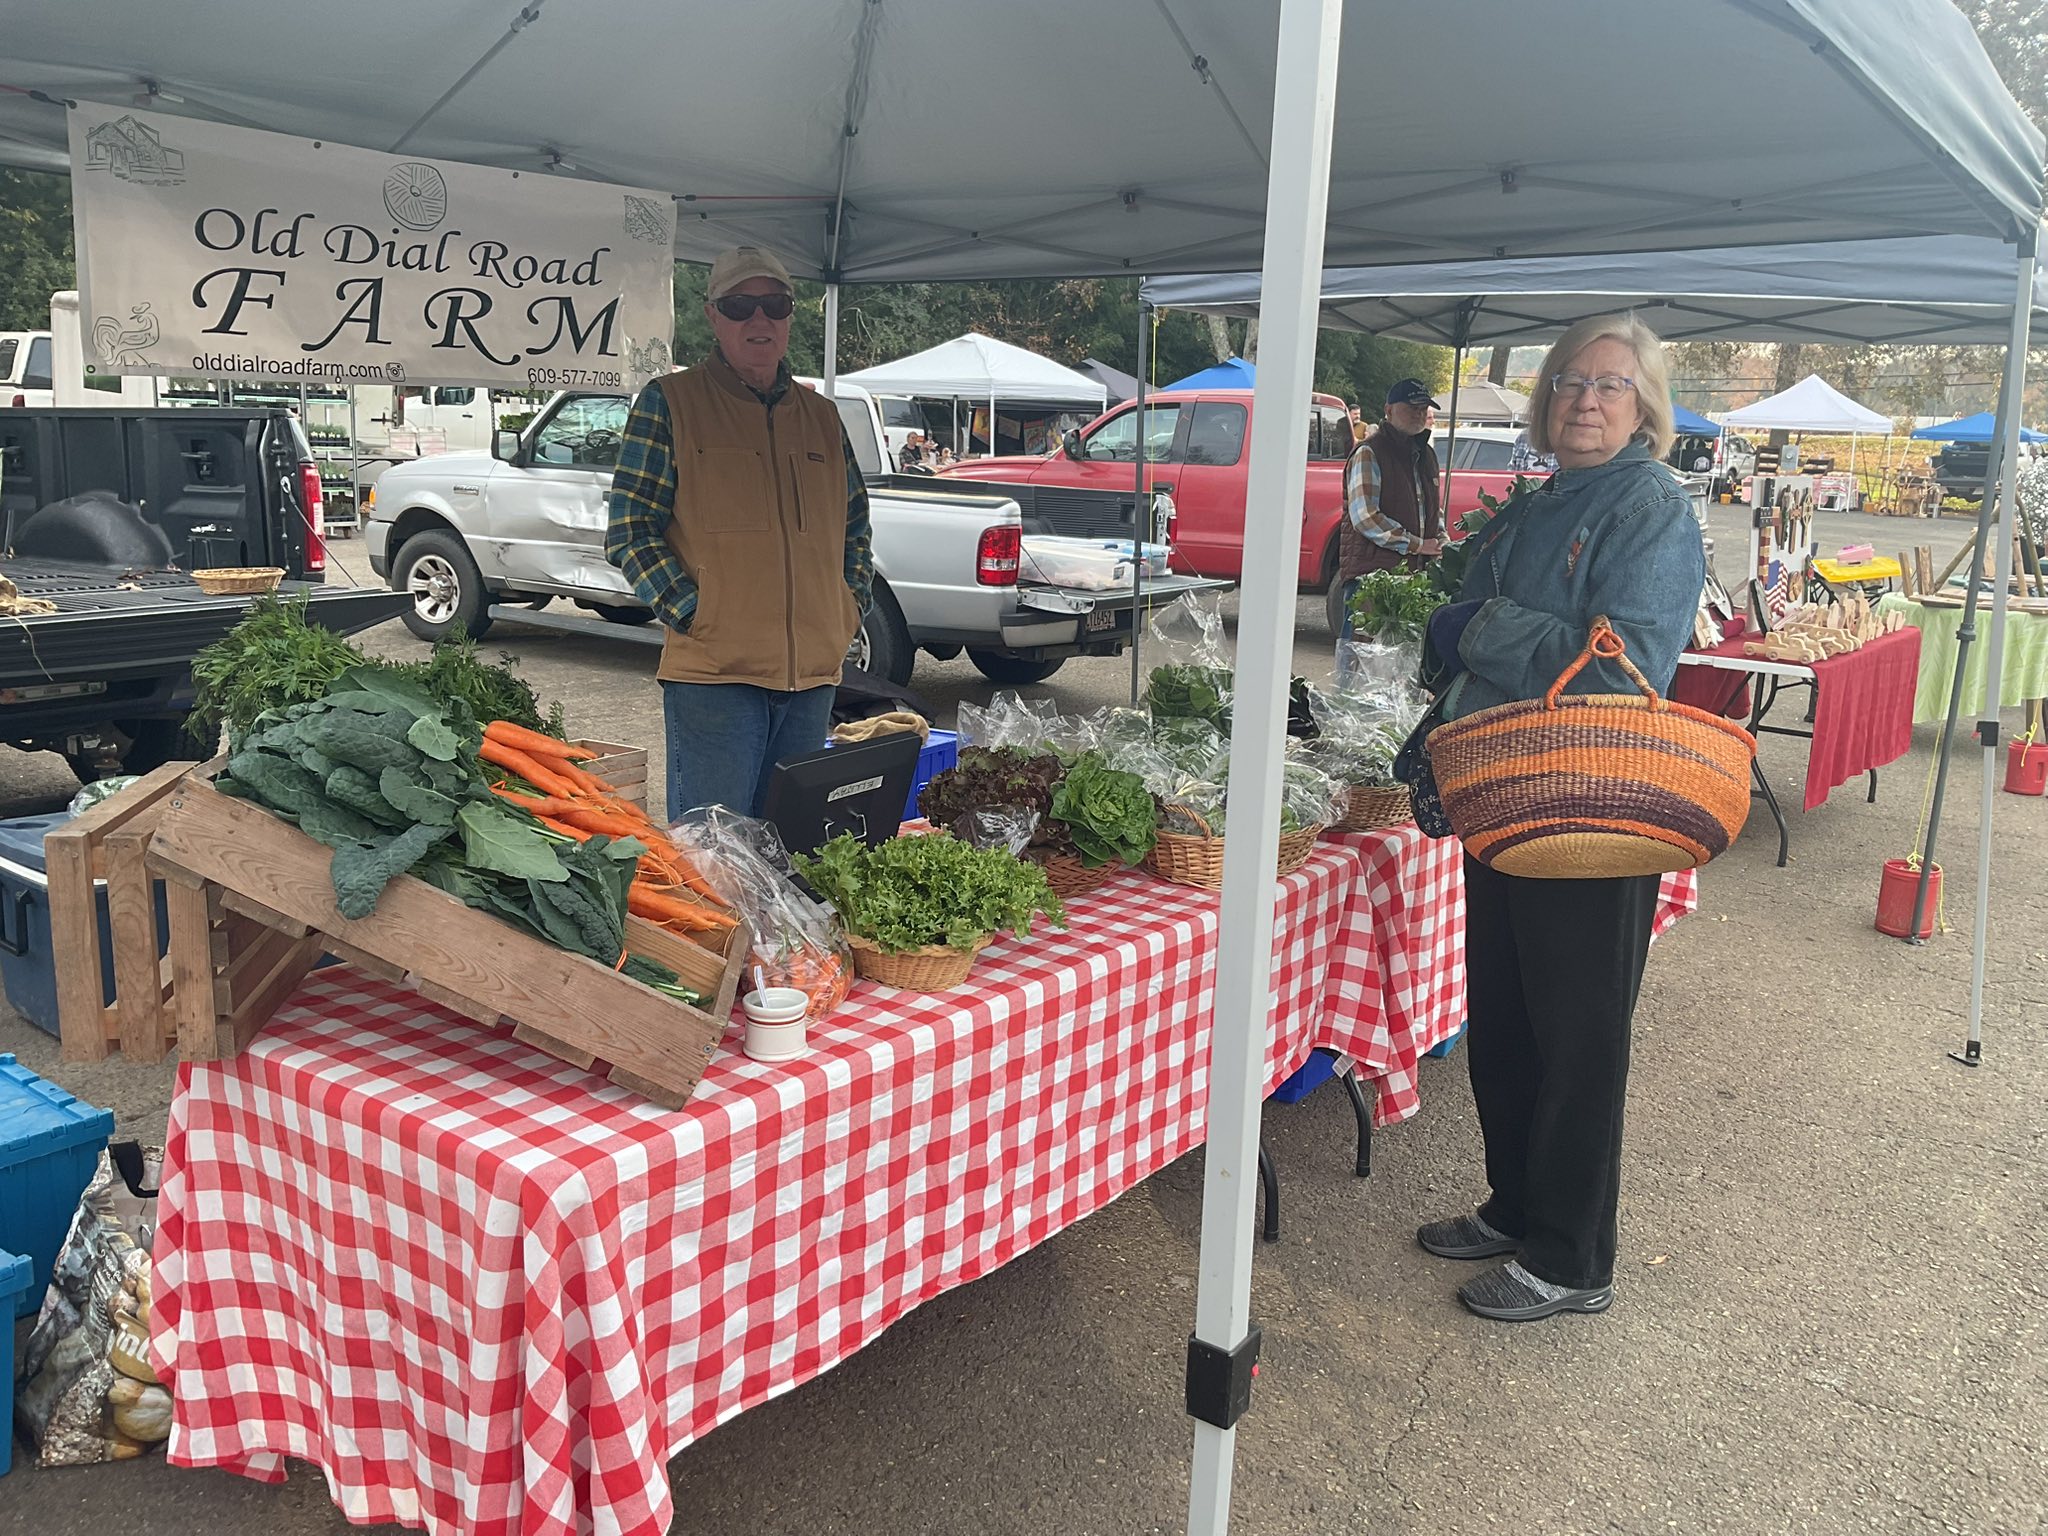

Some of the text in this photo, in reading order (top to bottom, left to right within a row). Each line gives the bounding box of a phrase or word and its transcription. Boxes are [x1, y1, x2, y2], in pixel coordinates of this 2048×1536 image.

[195, 208, 611, 289] Old Dial Road
[192, 267, 620, 366] FARM
[192, 353, 383, 379] olddialroadfarm.com
[527, 368, 621, 387] 609-577-7099
